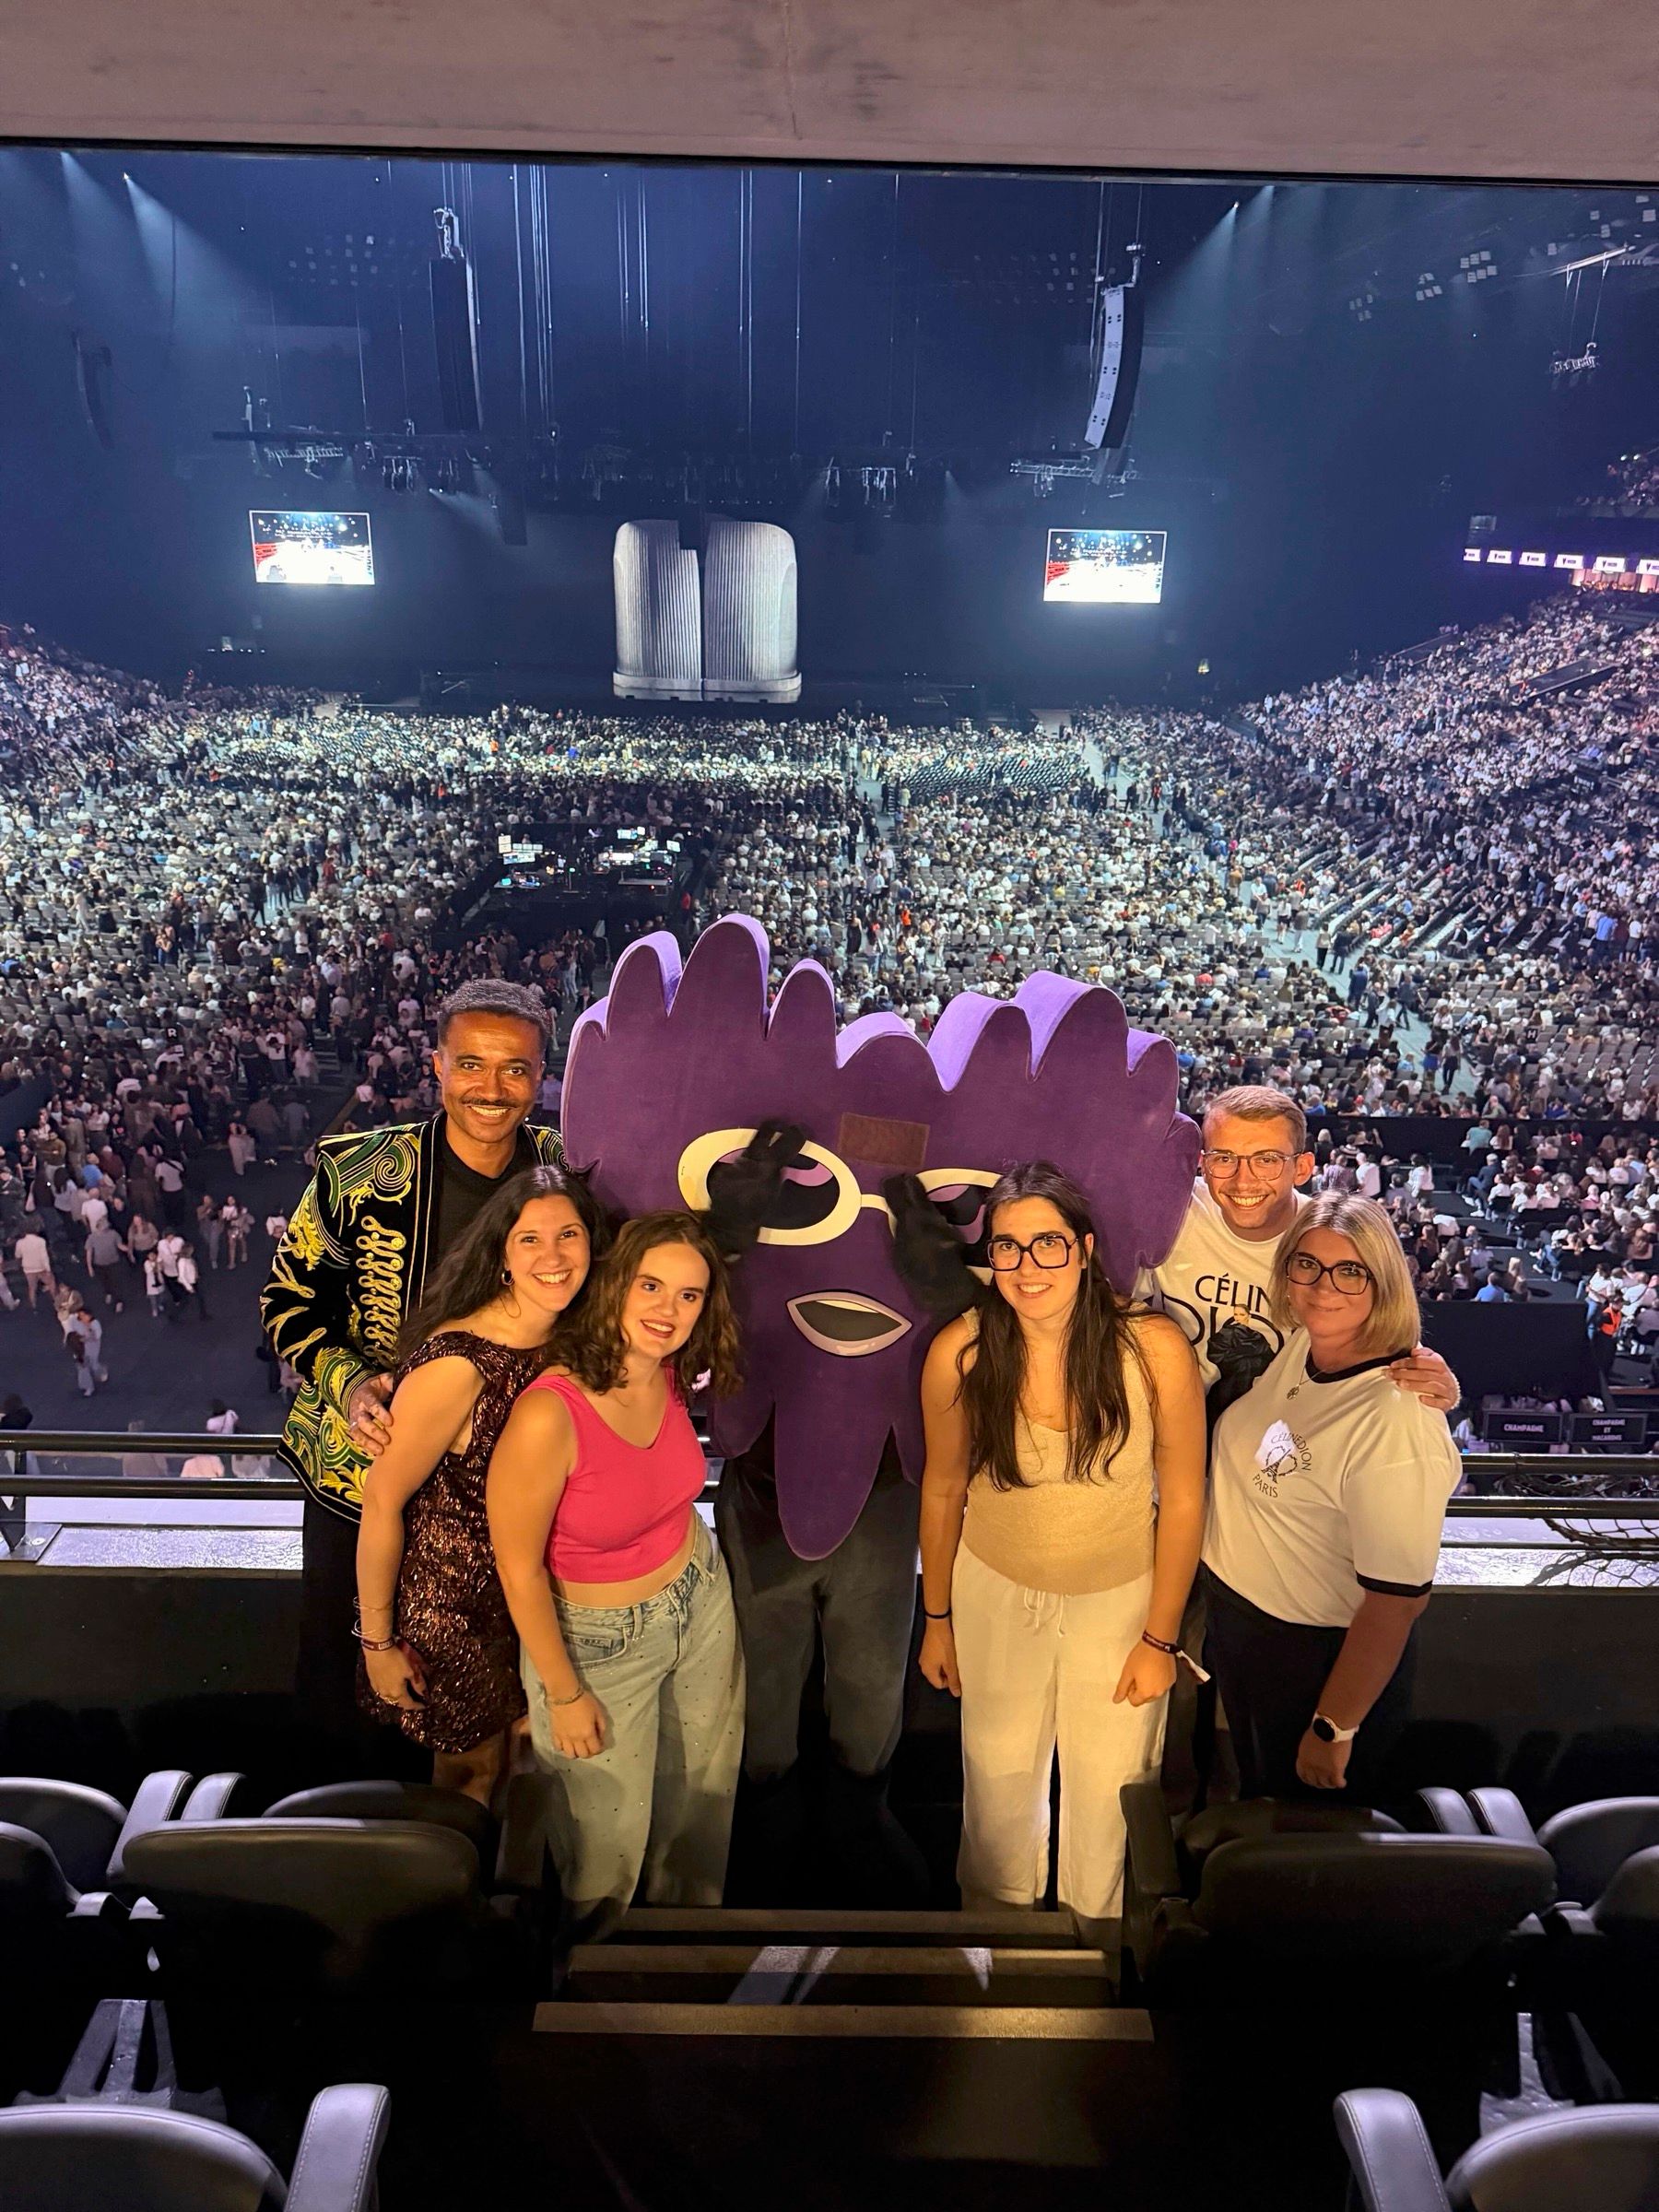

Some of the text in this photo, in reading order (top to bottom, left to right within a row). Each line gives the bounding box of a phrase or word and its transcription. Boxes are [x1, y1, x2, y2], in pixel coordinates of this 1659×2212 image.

[168, 1028, 177, 1038] R
[1527, 1030, 1536, 1039] H
[1194, 1273, 1271, 1312] CÉLIN
[1503, 1423, 1545, 1433] CHAMPAGNE
[1253, 1474, 1278, 1499] PARIS
